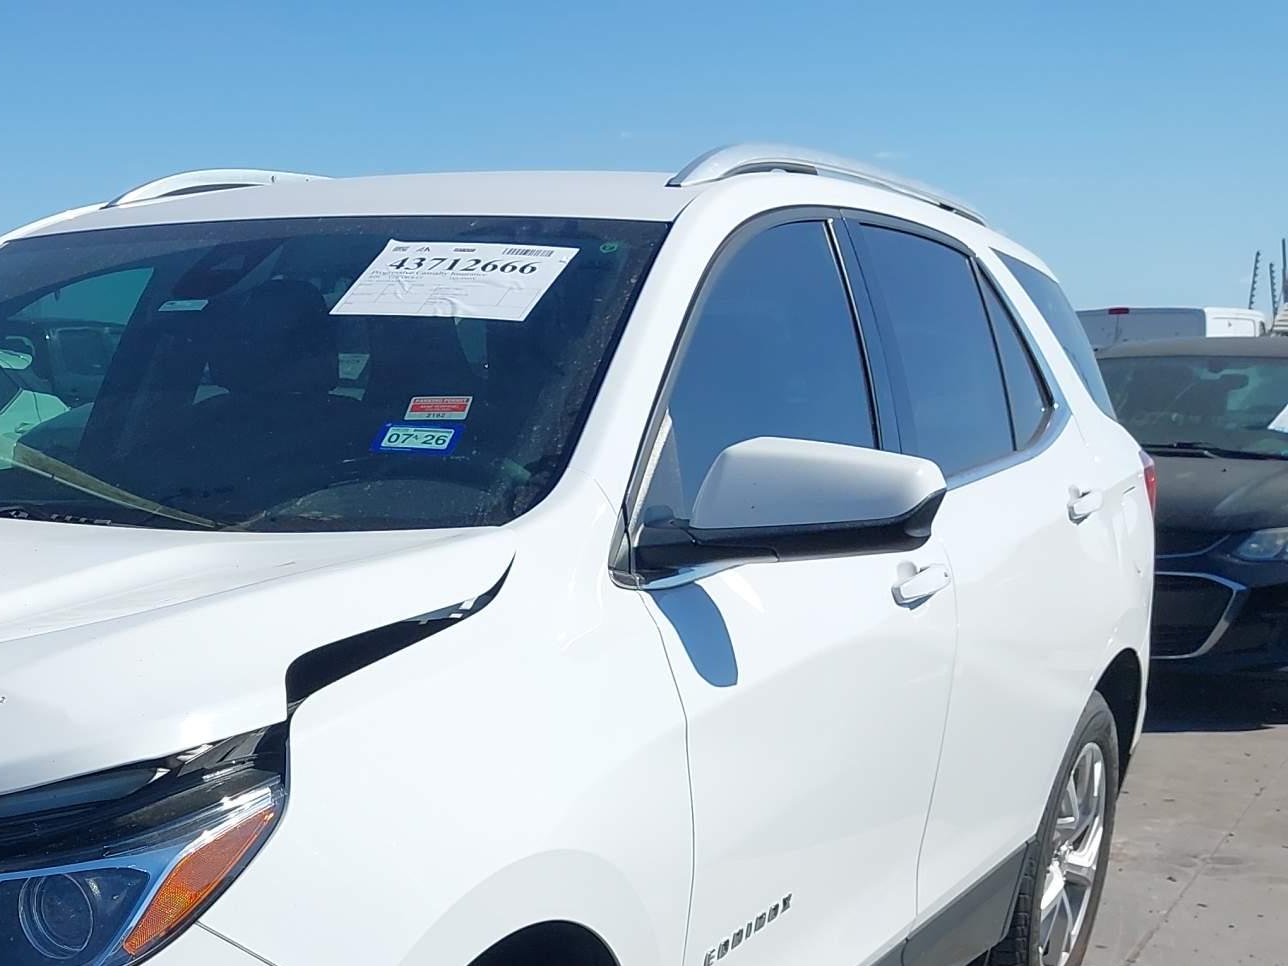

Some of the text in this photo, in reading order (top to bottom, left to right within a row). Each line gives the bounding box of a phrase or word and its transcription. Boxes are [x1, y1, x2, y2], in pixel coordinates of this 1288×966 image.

[388, 257, 545, 275] 43712666
[387, 433, 449, 446] 07 26
